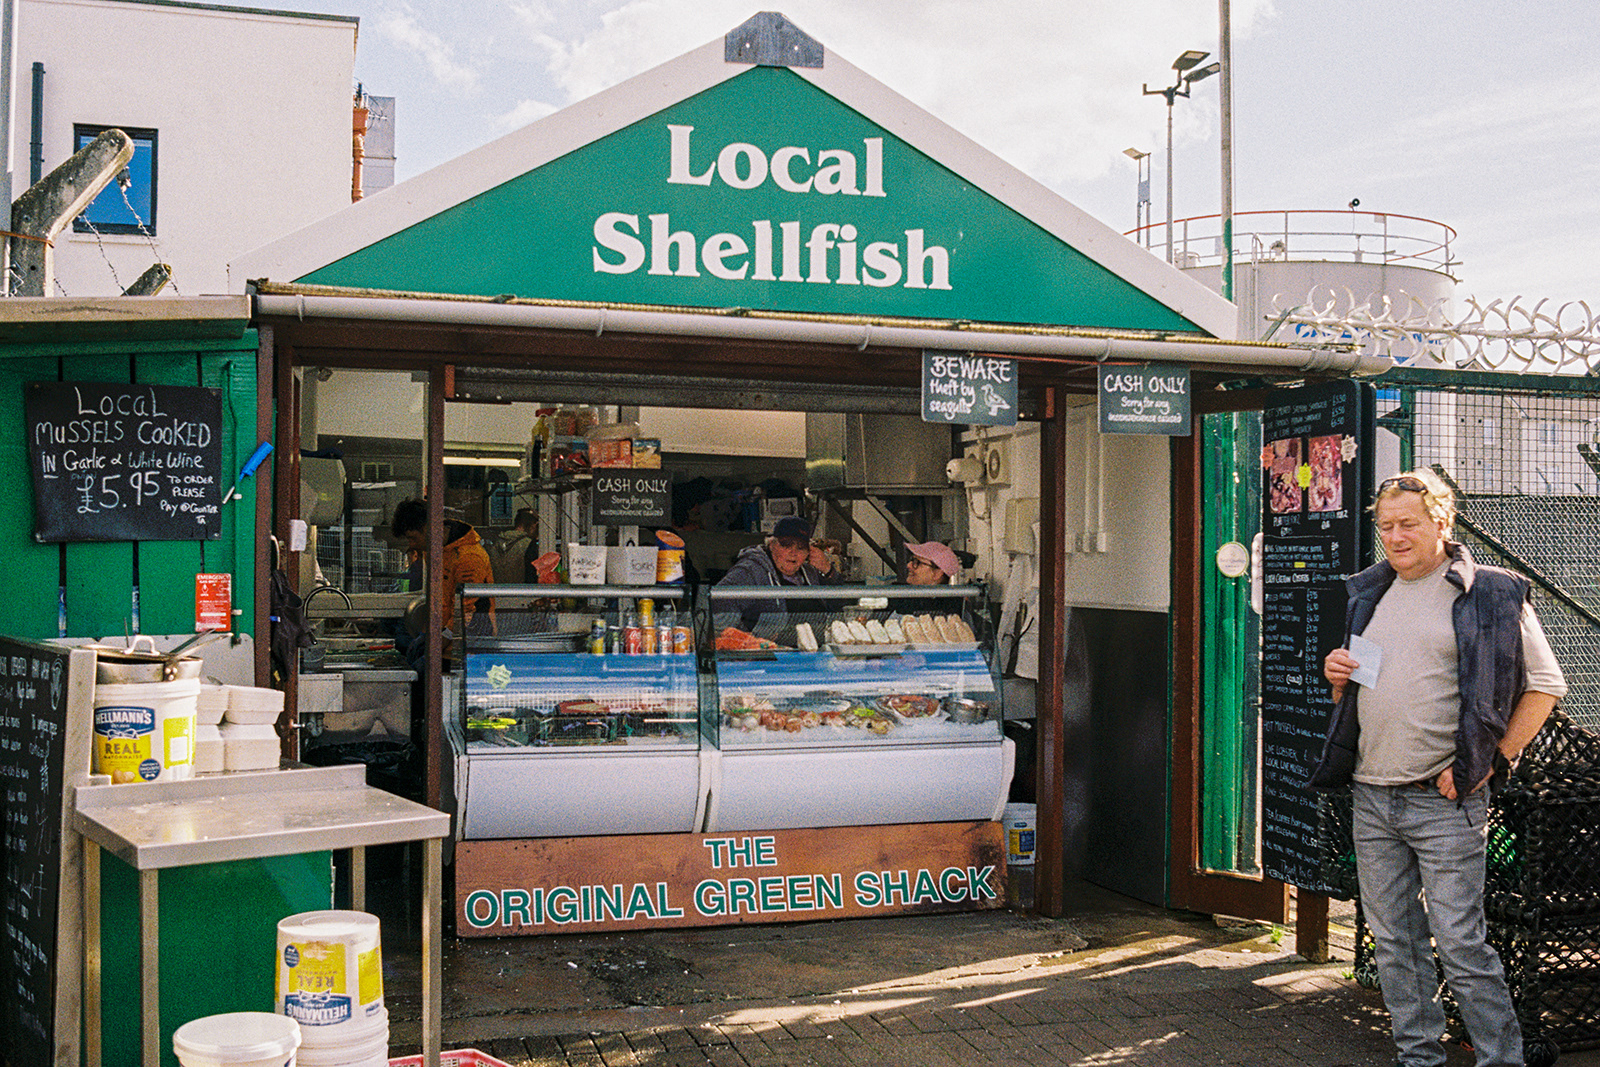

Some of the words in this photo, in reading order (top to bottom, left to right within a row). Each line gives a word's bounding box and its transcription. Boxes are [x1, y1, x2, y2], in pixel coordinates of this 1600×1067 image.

[667, 124, 887, 197] Local
[592, 211, 953, 290] Shellfish
[930, 355, 1011, 384] BEWARE
[930, 379, 959, 397] theft
[961, 380, 976, 408] by
[1104, 374, 1143, 393] CASH
[1148, 375, 1186, 395] ONLY
[929, 397, 972, 420] seagulls
[1121, 395, 1144, 415] Sorry
[1143, 396, 1154, 408] for
[1154, 400, 1170, 415] any
[63, 447, 107, 471] Garlic
[128, 450, 163, 469] White
[167, 452, 205, 469] Wine
[183, 475, 214, 484] ORDER
[597, 478, 631, 493] CASH
[635, 478, 668, 494] ONLY
[76, 471, 161, 514] £5.95
[172, 486, 206, 498] PLEASE
[160, 499, 179, 517] PAY
[95, 709, 152, 725] HELLMANN'S
[1275, 720, 1296, 736] MUSSELS
[105, 743, 141, 755] REAL
[1265, 756, 1280, 770] LOCAL
[703, 836, 777, 869] THE
[464, 882, 685, 930] ORIGINAL
[692, 873, 845, 918] GREEN
[853, 864, 998, 910] SHACK
[297, 974, 336, 988] REAL
